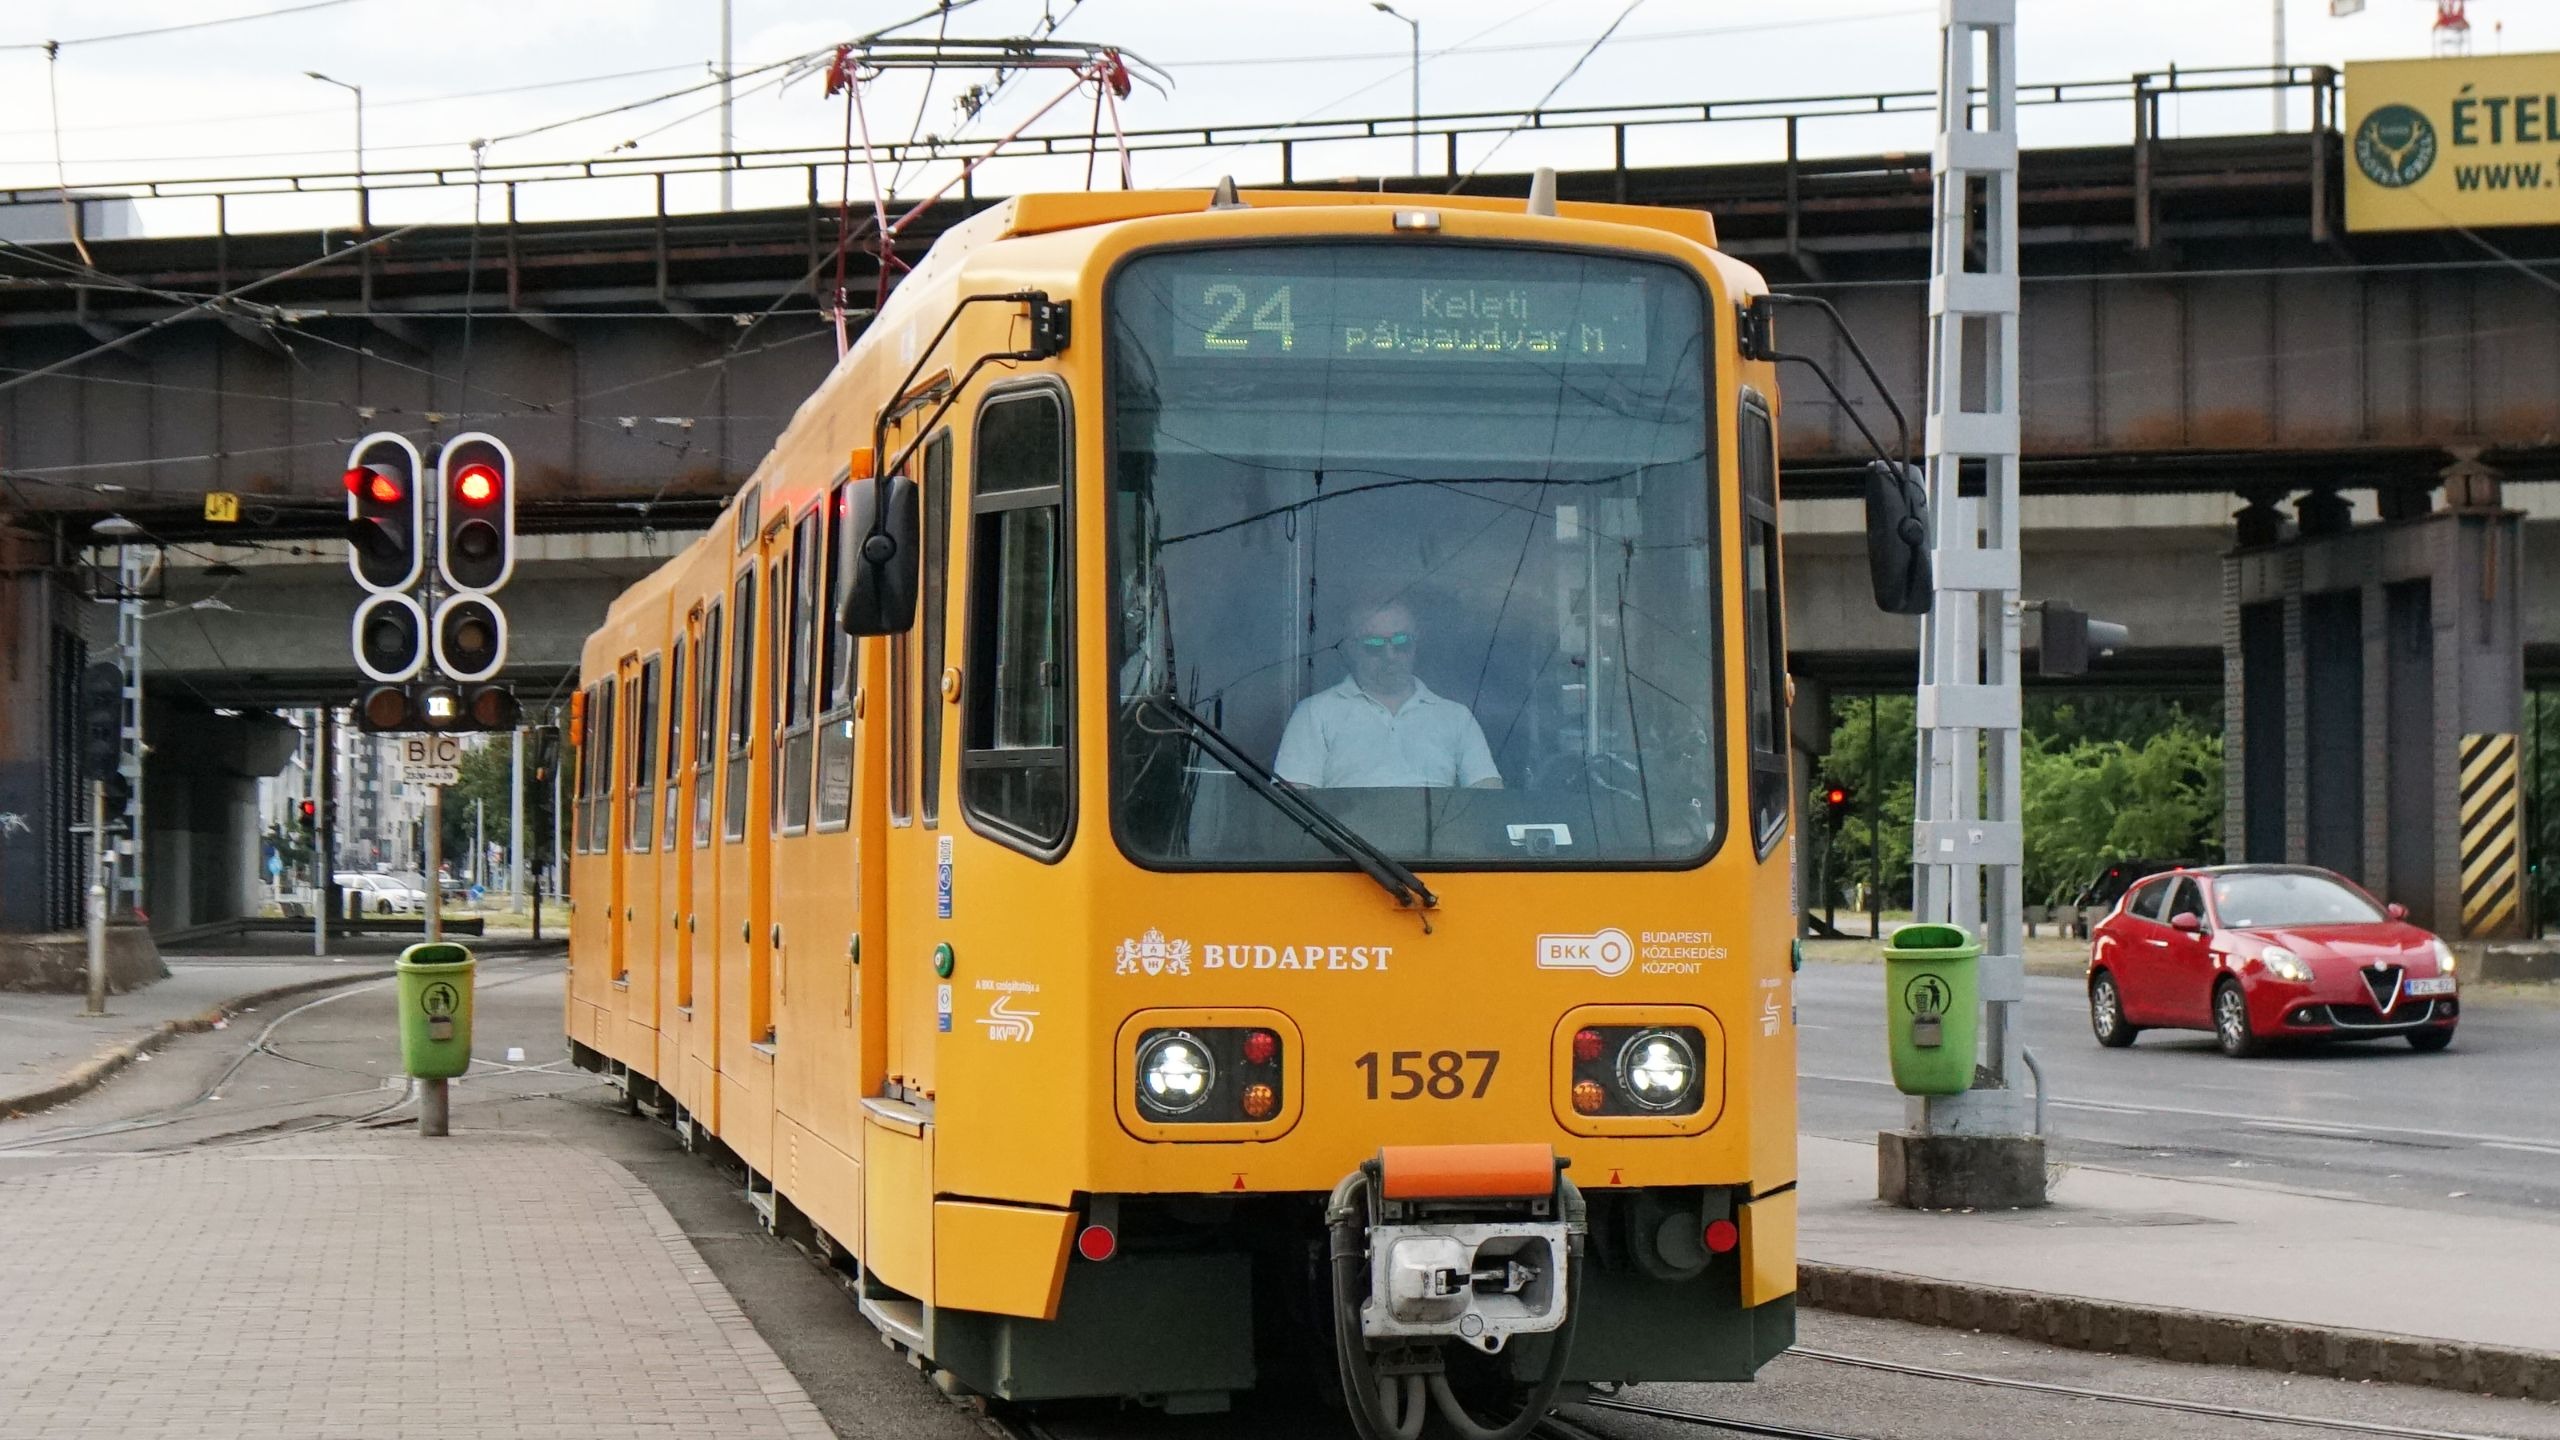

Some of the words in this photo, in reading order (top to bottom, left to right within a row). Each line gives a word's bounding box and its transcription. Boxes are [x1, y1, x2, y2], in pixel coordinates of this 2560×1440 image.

[2455, 155, 2560, 191] www.
[1420, 288, 1528, 320] Keleti
[1202, 284, 1295, 351] 24
[1345, 321, 1567, 353] pályaudvar
[1581, 323, 1605, 352] M
[408, 741, 425, 761] B
[438, 740, 456, 761] C
[1641, 931, 1713, 944] BUDAPESTI
[1203, 944, 1393, 970] BUDAPEST
[1550, 944, 1590, 959] BKK
[1641, 945, 1728, 960] KÖZLEKEDÉSI
[1641, 960, 1703, 974] KÖZPONT
[1355, 1050, 1500, 1100] 1587
